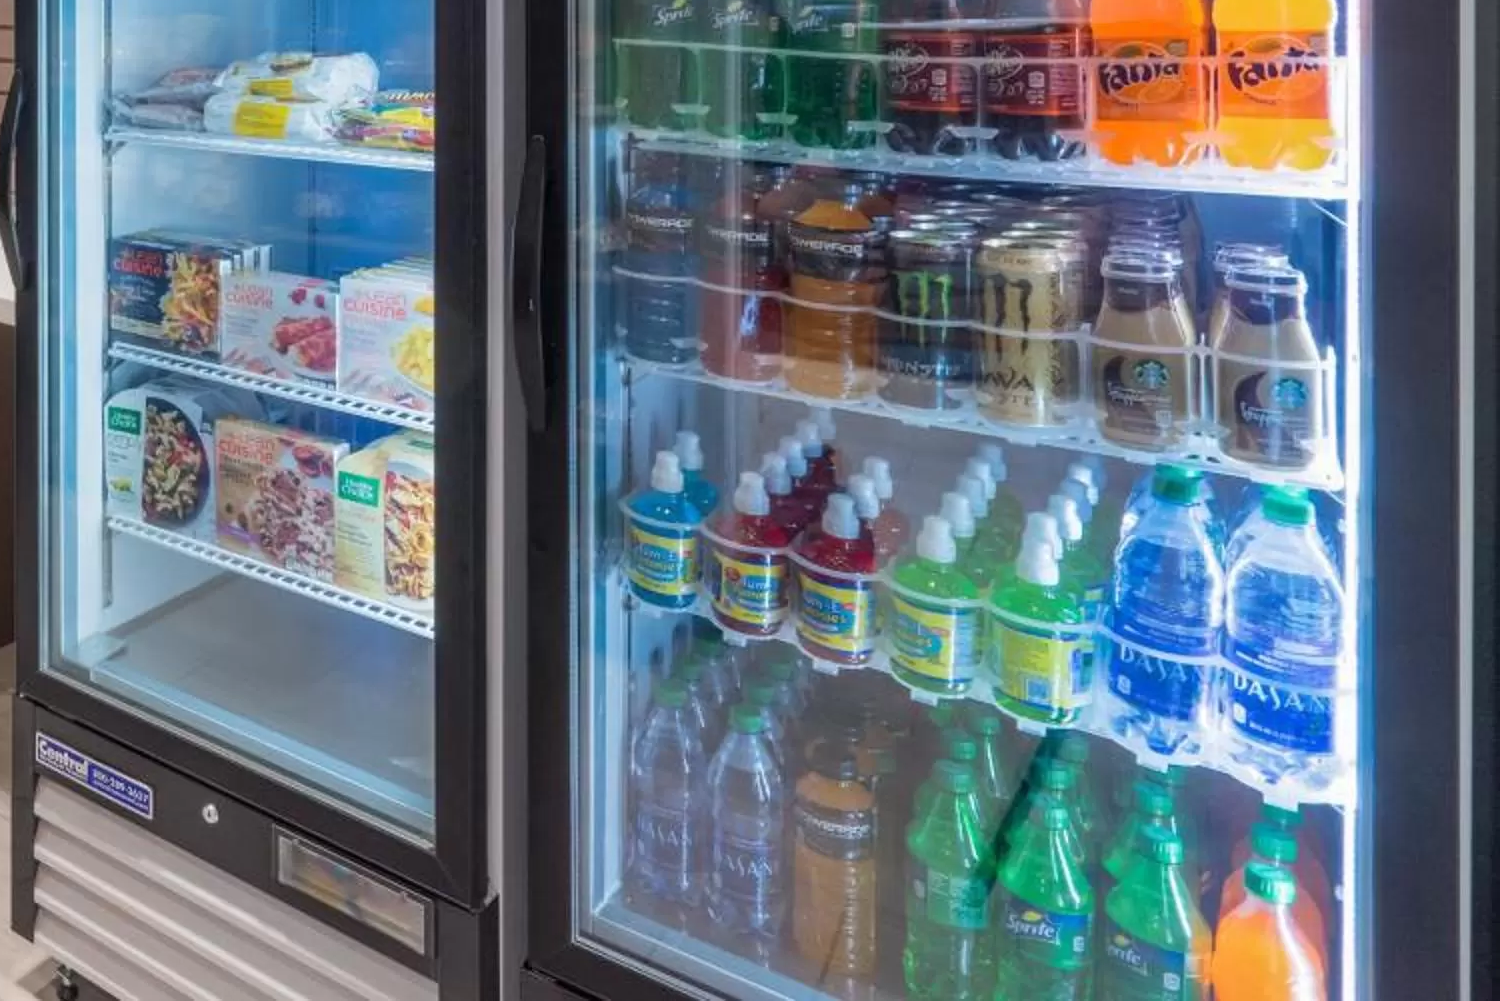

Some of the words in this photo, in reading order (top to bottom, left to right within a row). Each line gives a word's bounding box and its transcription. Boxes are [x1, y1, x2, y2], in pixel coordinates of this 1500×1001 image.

[1099, 52, 1181, 95] Fanta
[1227, 46, 1320, 92] Fanta
[40, 740, 88, 776] Central
[1006, 913, 1056, 939] Sprite
